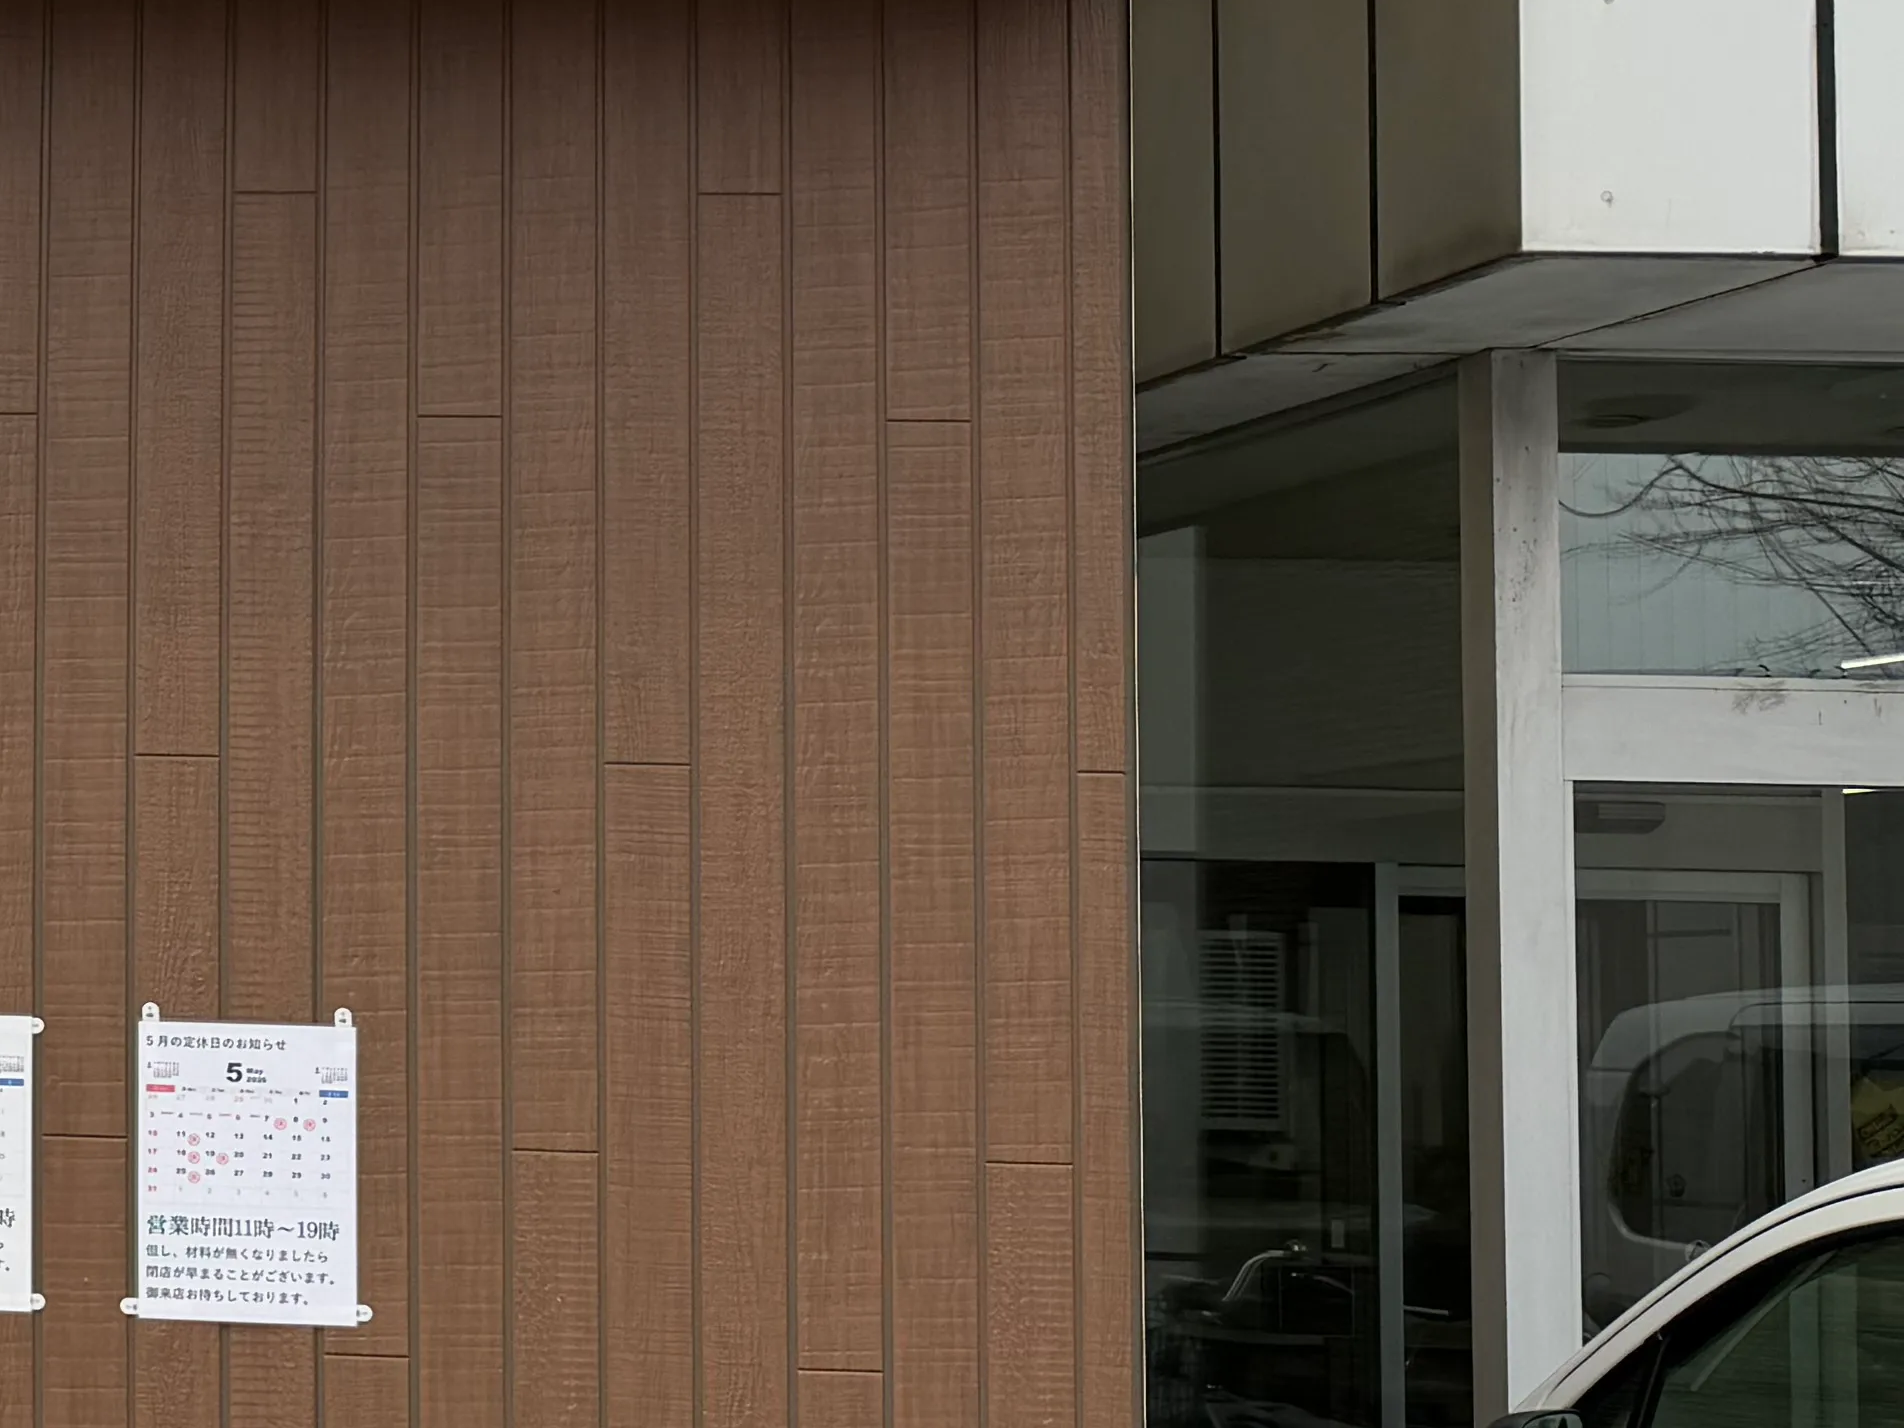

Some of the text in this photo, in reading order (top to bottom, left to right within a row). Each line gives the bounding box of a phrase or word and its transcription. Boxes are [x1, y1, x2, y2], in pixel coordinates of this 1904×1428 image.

[146, 1035, 286, 1050] 5月の定休日のお知らせ
[226, 1062, 243, 1082] 5
